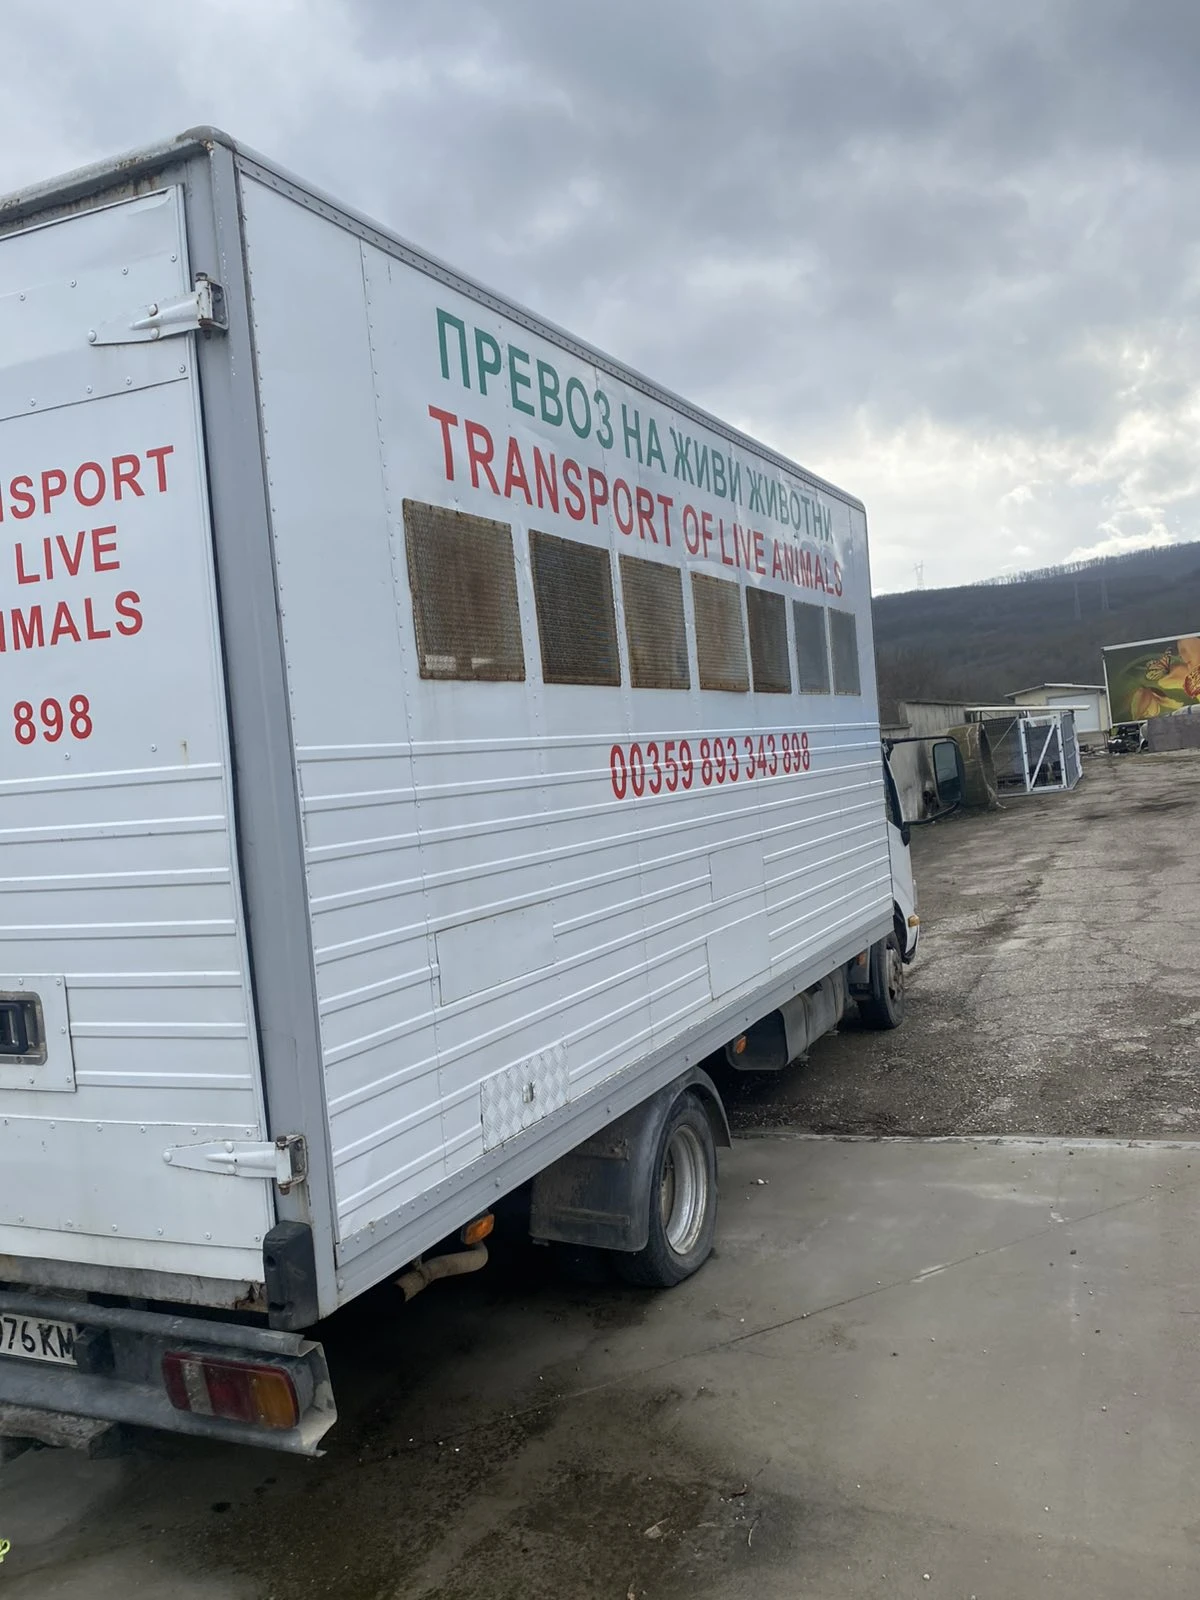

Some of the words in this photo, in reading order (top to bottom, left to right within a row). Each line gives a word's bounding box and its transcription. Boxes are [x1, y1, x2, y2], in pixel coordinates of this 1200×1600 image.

[436, 307, 614, 450] ПРЕВОЗ
[622, 403, 667, 474] НА
[669, 426, 743, 506] ЖИВИ
[746, 466, 834, 545] ЖИВОТНИ
[428, 404, 674, 548] TRANSPORT
[682, 504, 713, 559] OF
[719, 518, 766, 576] LIVE
[772, 538, 844, 598] ANIMALS
[15, 525, 120, 584] LIVE
[13, 694, 93, 744] 898
[610, 739, 694, 800] 00359
[699, 737, 739, 786] 893
[744, 734, 778, 779] 343
[781, 732, 810, 774] 898
